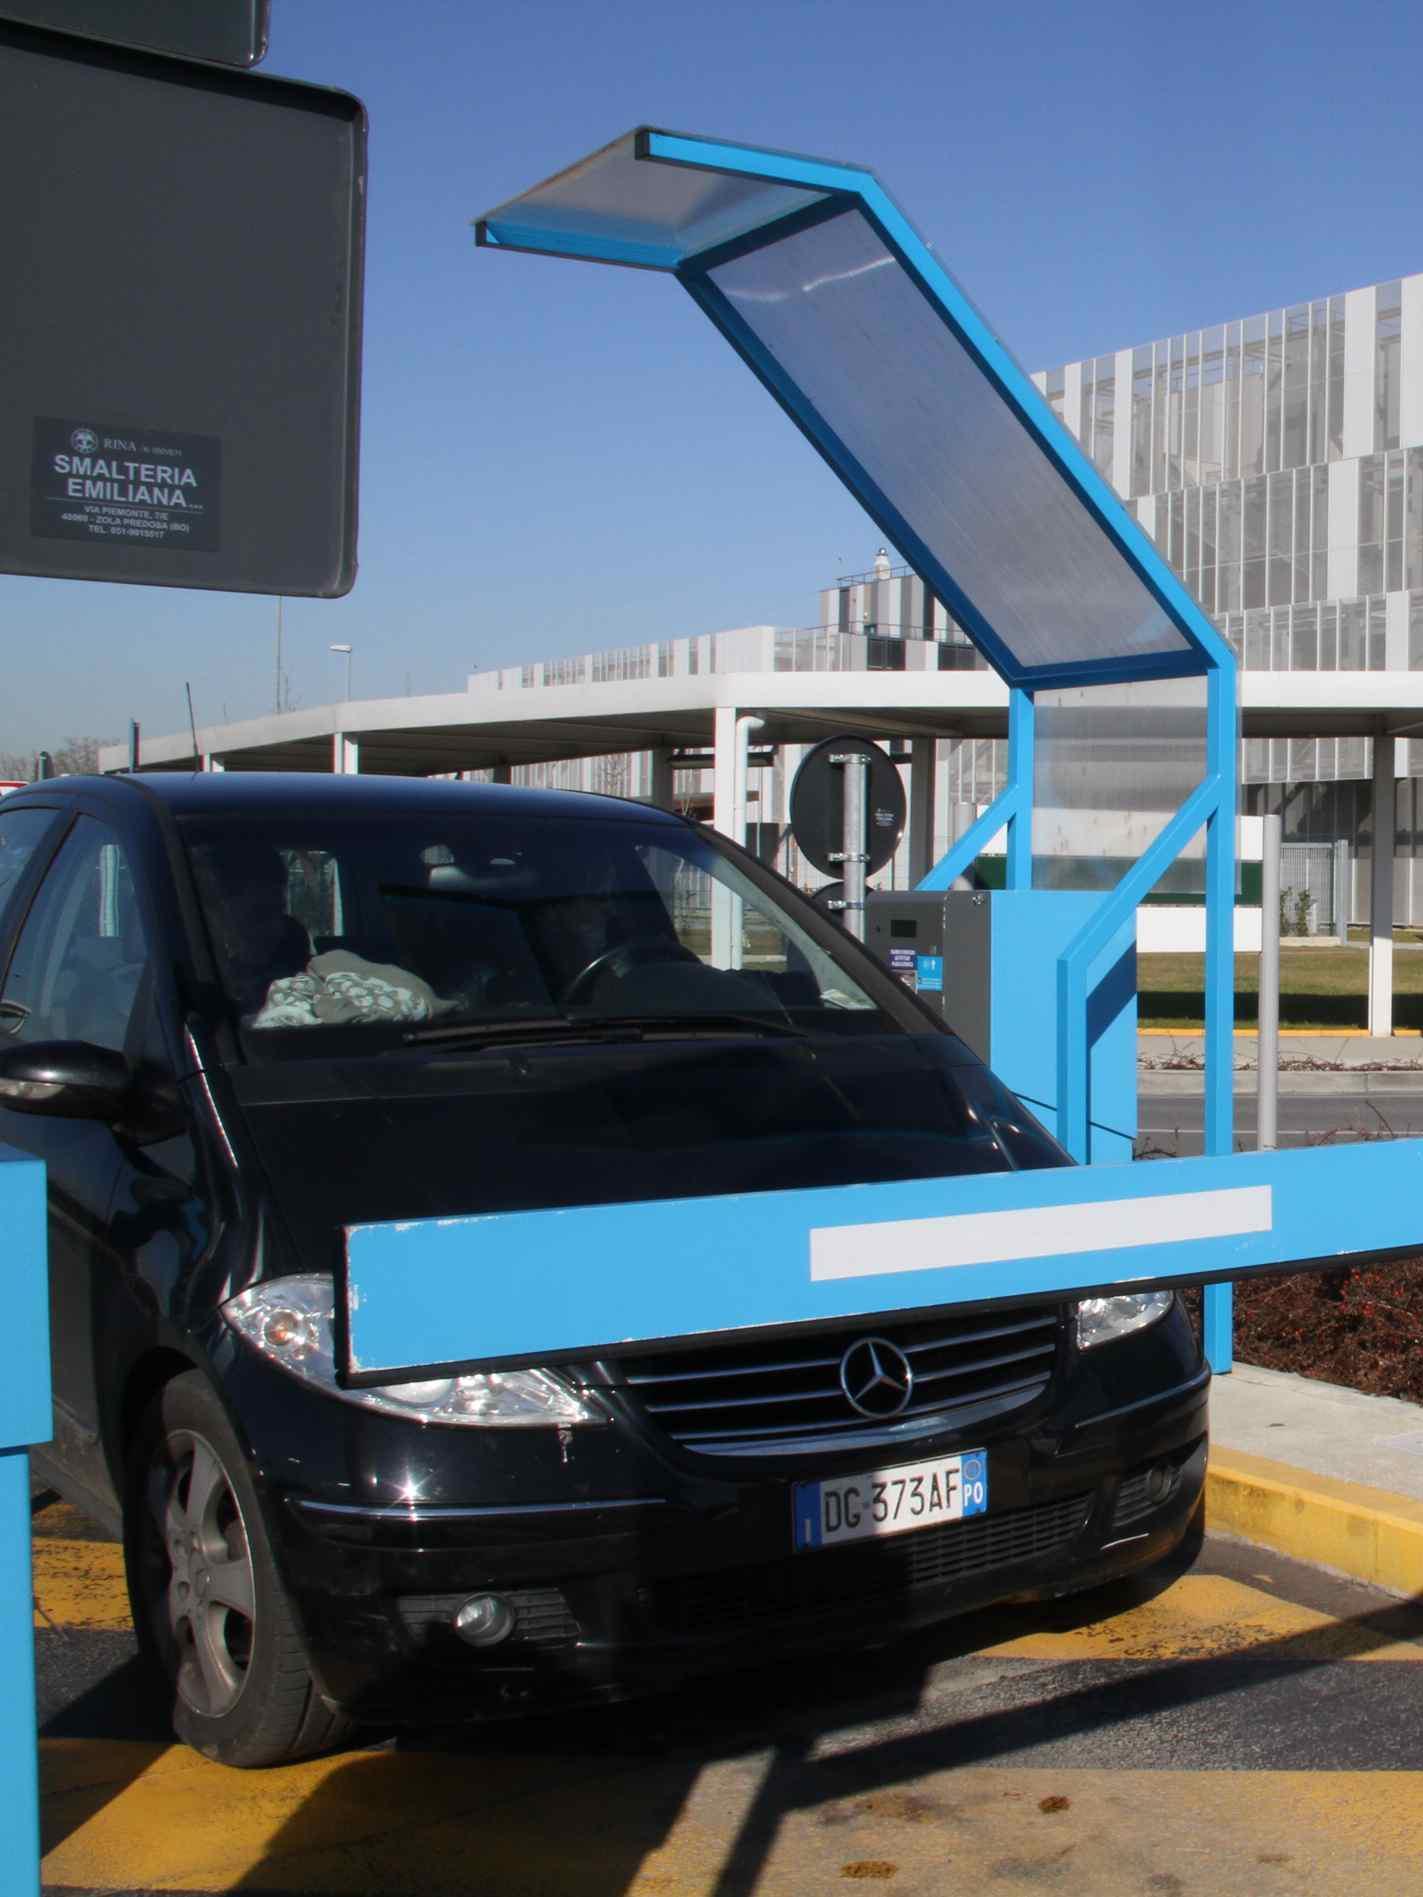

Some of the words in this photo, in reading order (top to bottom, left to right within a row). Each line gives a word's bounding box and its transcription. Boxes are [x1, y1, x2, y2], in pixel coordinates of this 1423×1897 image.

[103, 437, 137, 452] RINA
[53, 453, 198, 487] SMALTERIA
[67, 478, 188, 508] EMILIANA
[963, 1481, 984, 1507] PO
